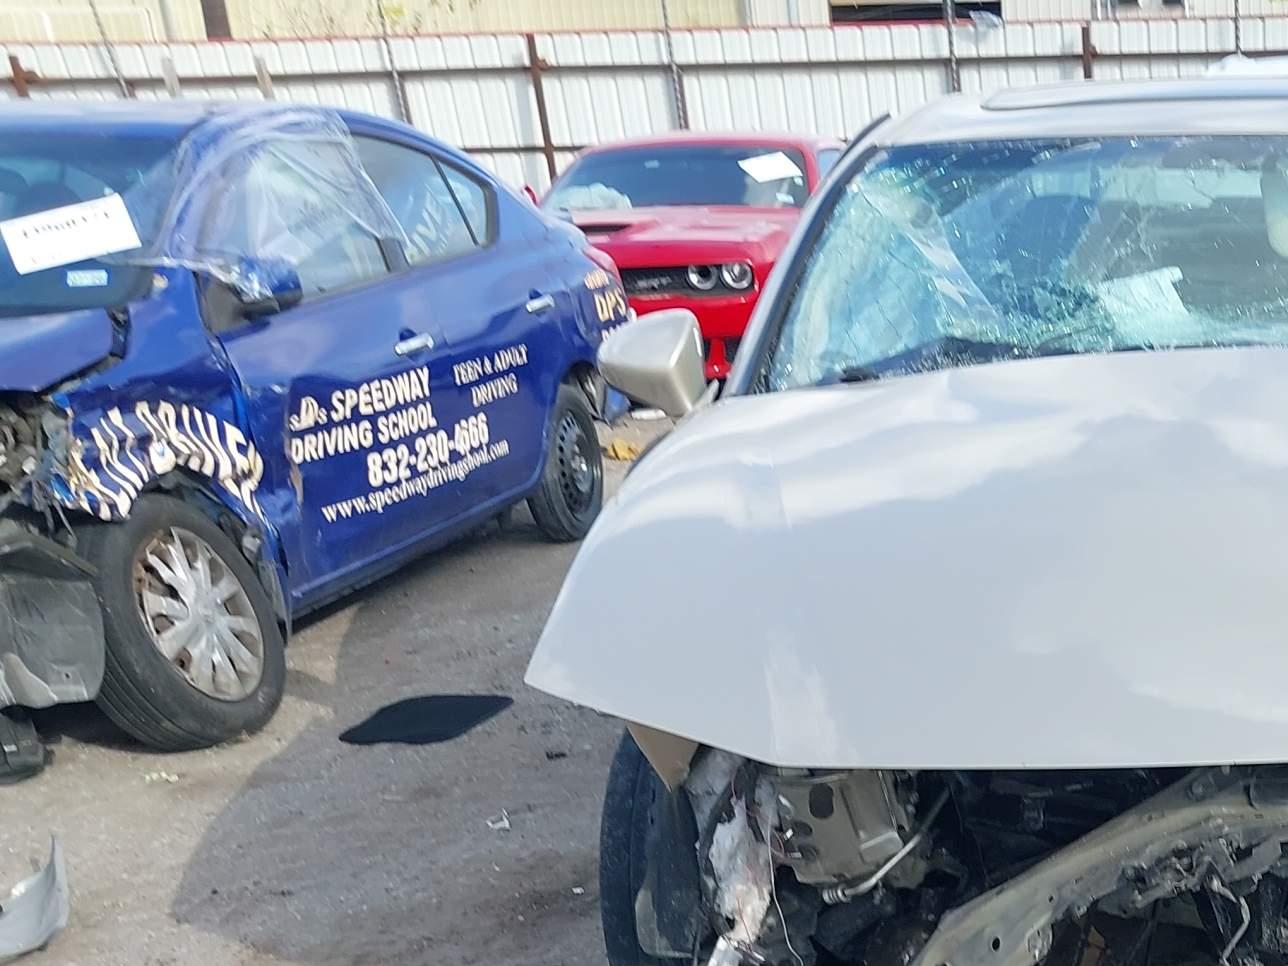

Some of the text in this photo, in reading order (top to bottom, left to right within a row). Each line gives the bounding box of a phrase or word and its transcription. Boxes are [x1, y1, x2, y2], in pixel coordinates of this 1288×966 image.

[594, 287, 627, 322] DPS
[453, 358, 483, 387] TEEN
[493, 343, 529, 372] ADULT
[330, 365, 432, 422] SPEEDWAY
[471, 373, 519, 408] DRIVING
[290, 401, 438, 465] DRIVING SCHOOL
